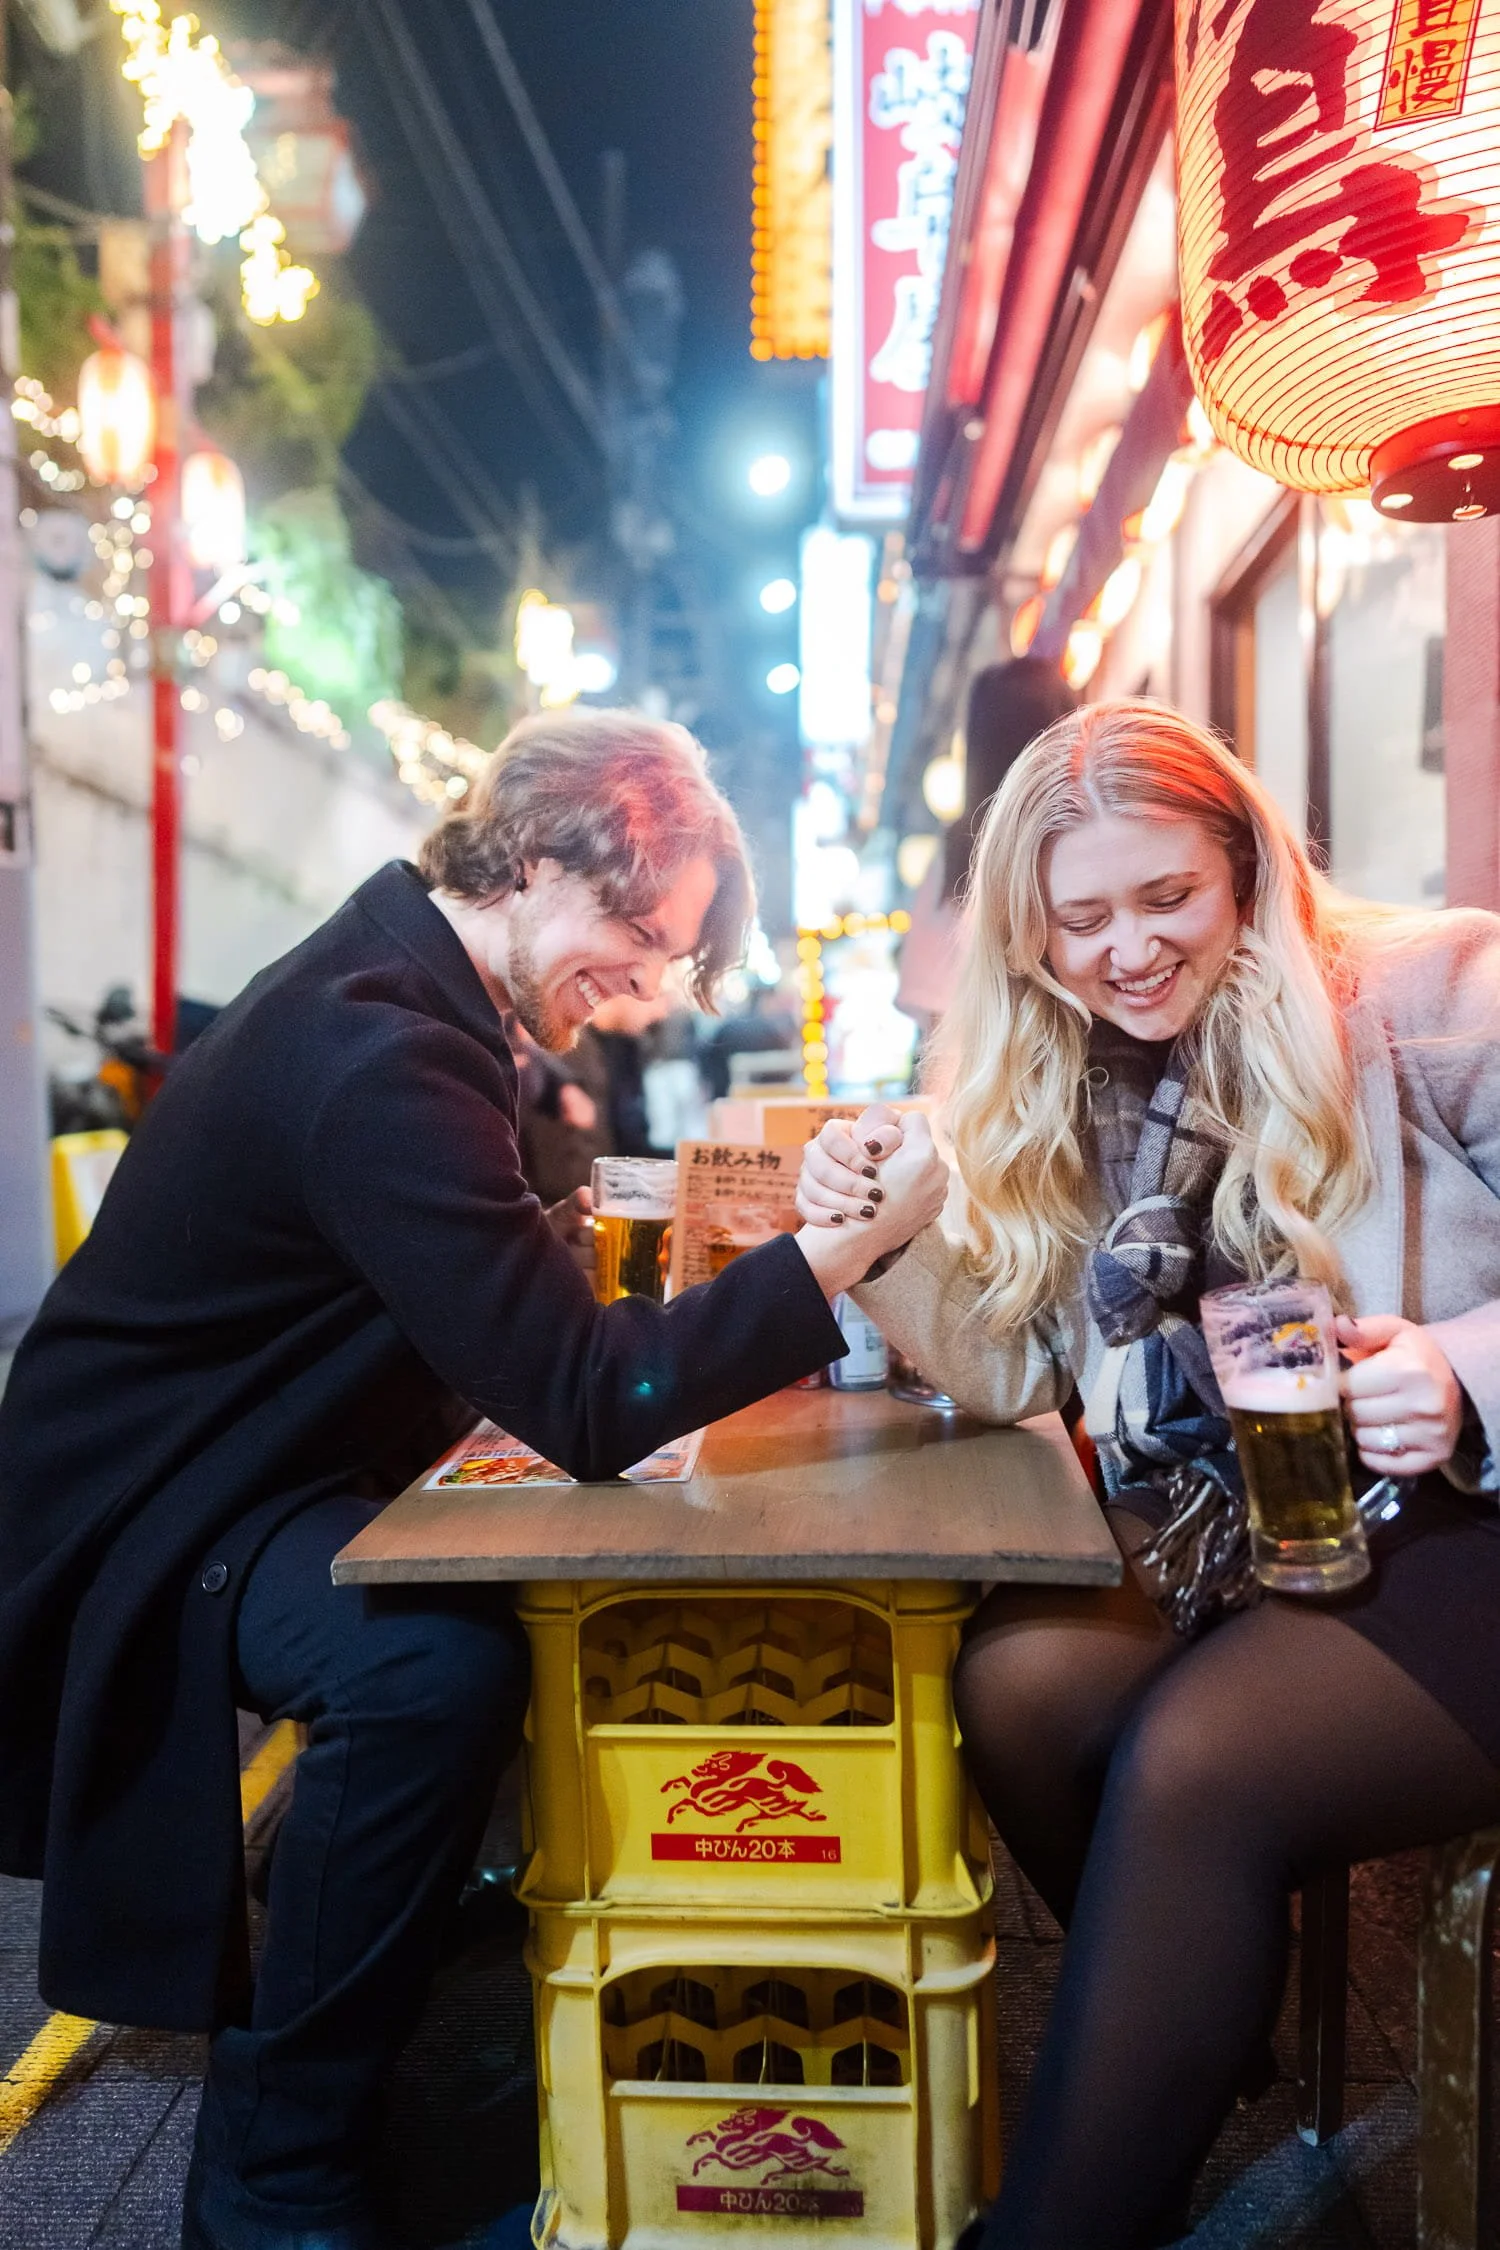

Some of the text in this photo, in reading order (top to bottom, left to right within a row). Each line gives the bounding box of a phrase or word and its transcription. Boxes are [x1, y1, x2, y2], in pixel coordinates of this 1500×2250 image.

[692, 1147, 782, 1171] お飲み物
[695, 1837, 796, 1860] 中びん20本
[821, 1848, 837, 1861] 16
